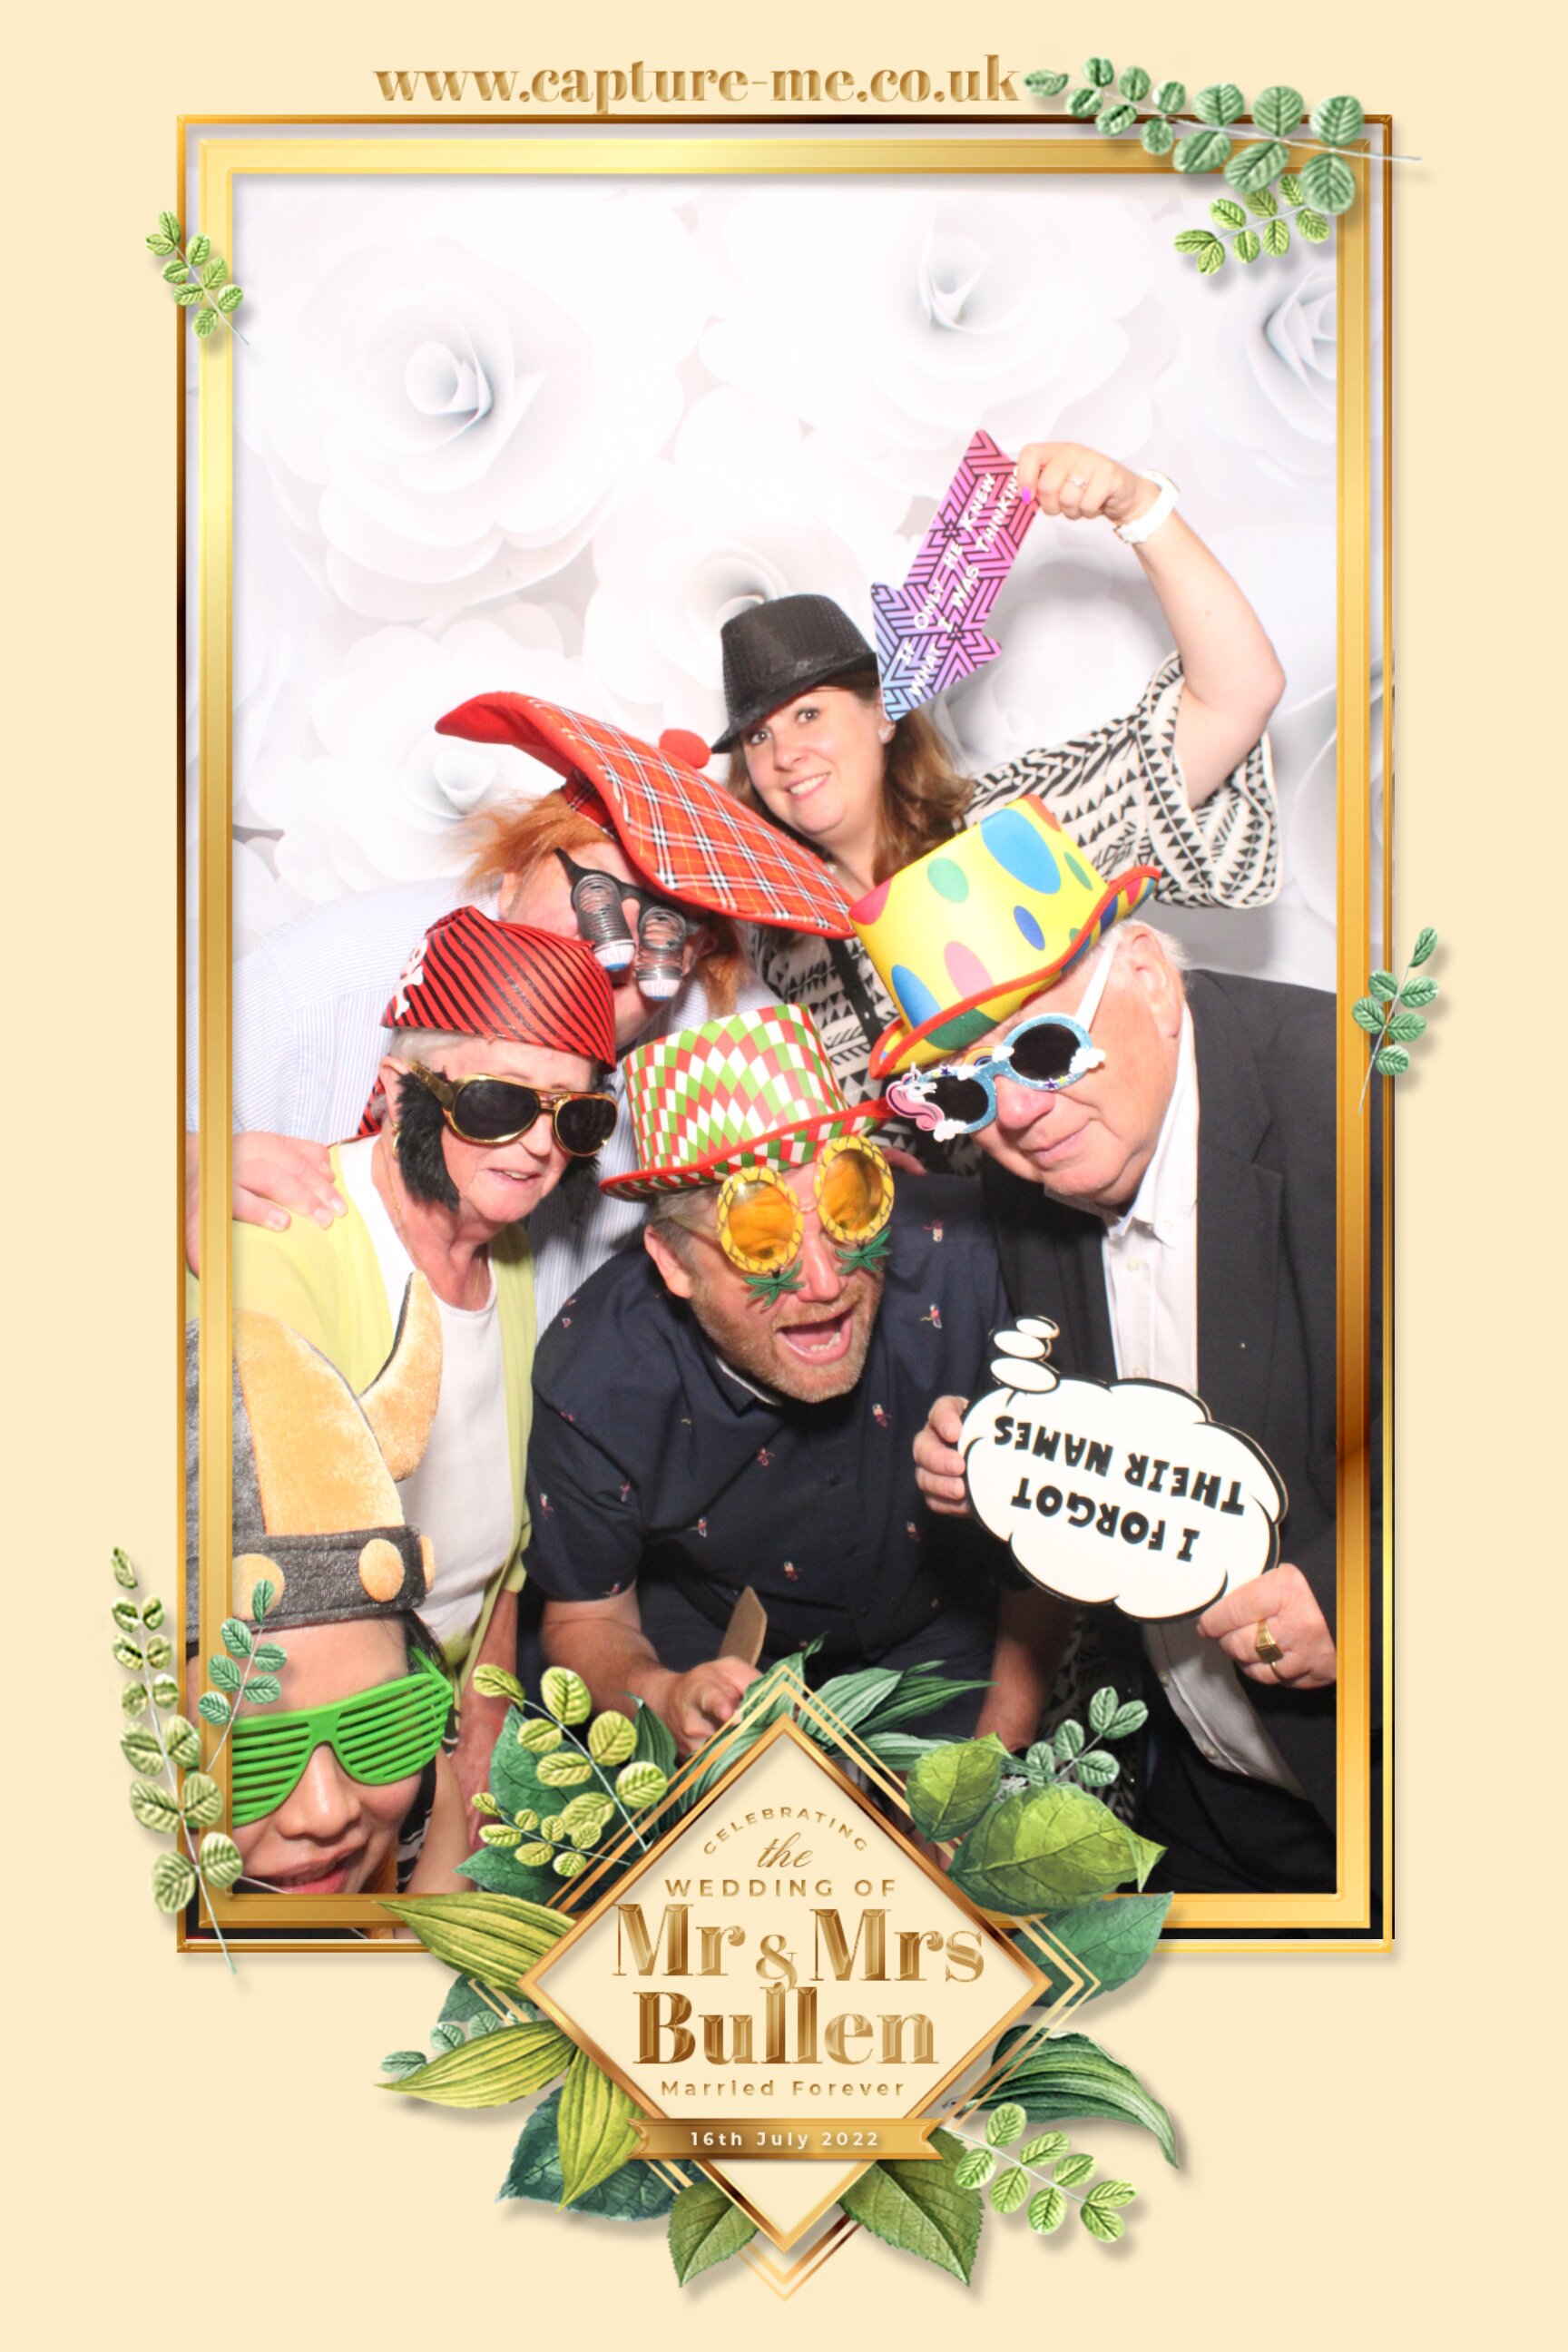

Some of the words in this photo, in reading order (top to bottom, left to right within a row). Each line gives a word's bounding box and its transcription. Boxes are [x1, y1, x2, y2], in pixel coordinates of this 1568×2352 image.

[895, 641, 916, 668] IF
[913, 578, 945, 631] ONLY
[941, 543, 963, 569] HE
[959, 473, 995, 533] KNEW
[908, 642, 941, 697] WHAT
[950, 564, 979, 608] WAS
[975, 466, 1018, 553] THINKIN
[994, 1415, 1114, 1477] NAMES
[1010, 1477, 1166, 1551] FORGOT
[1124, 1452, 1245, 1516] THEIR
[1176, 1528, 1200, 1563] I
